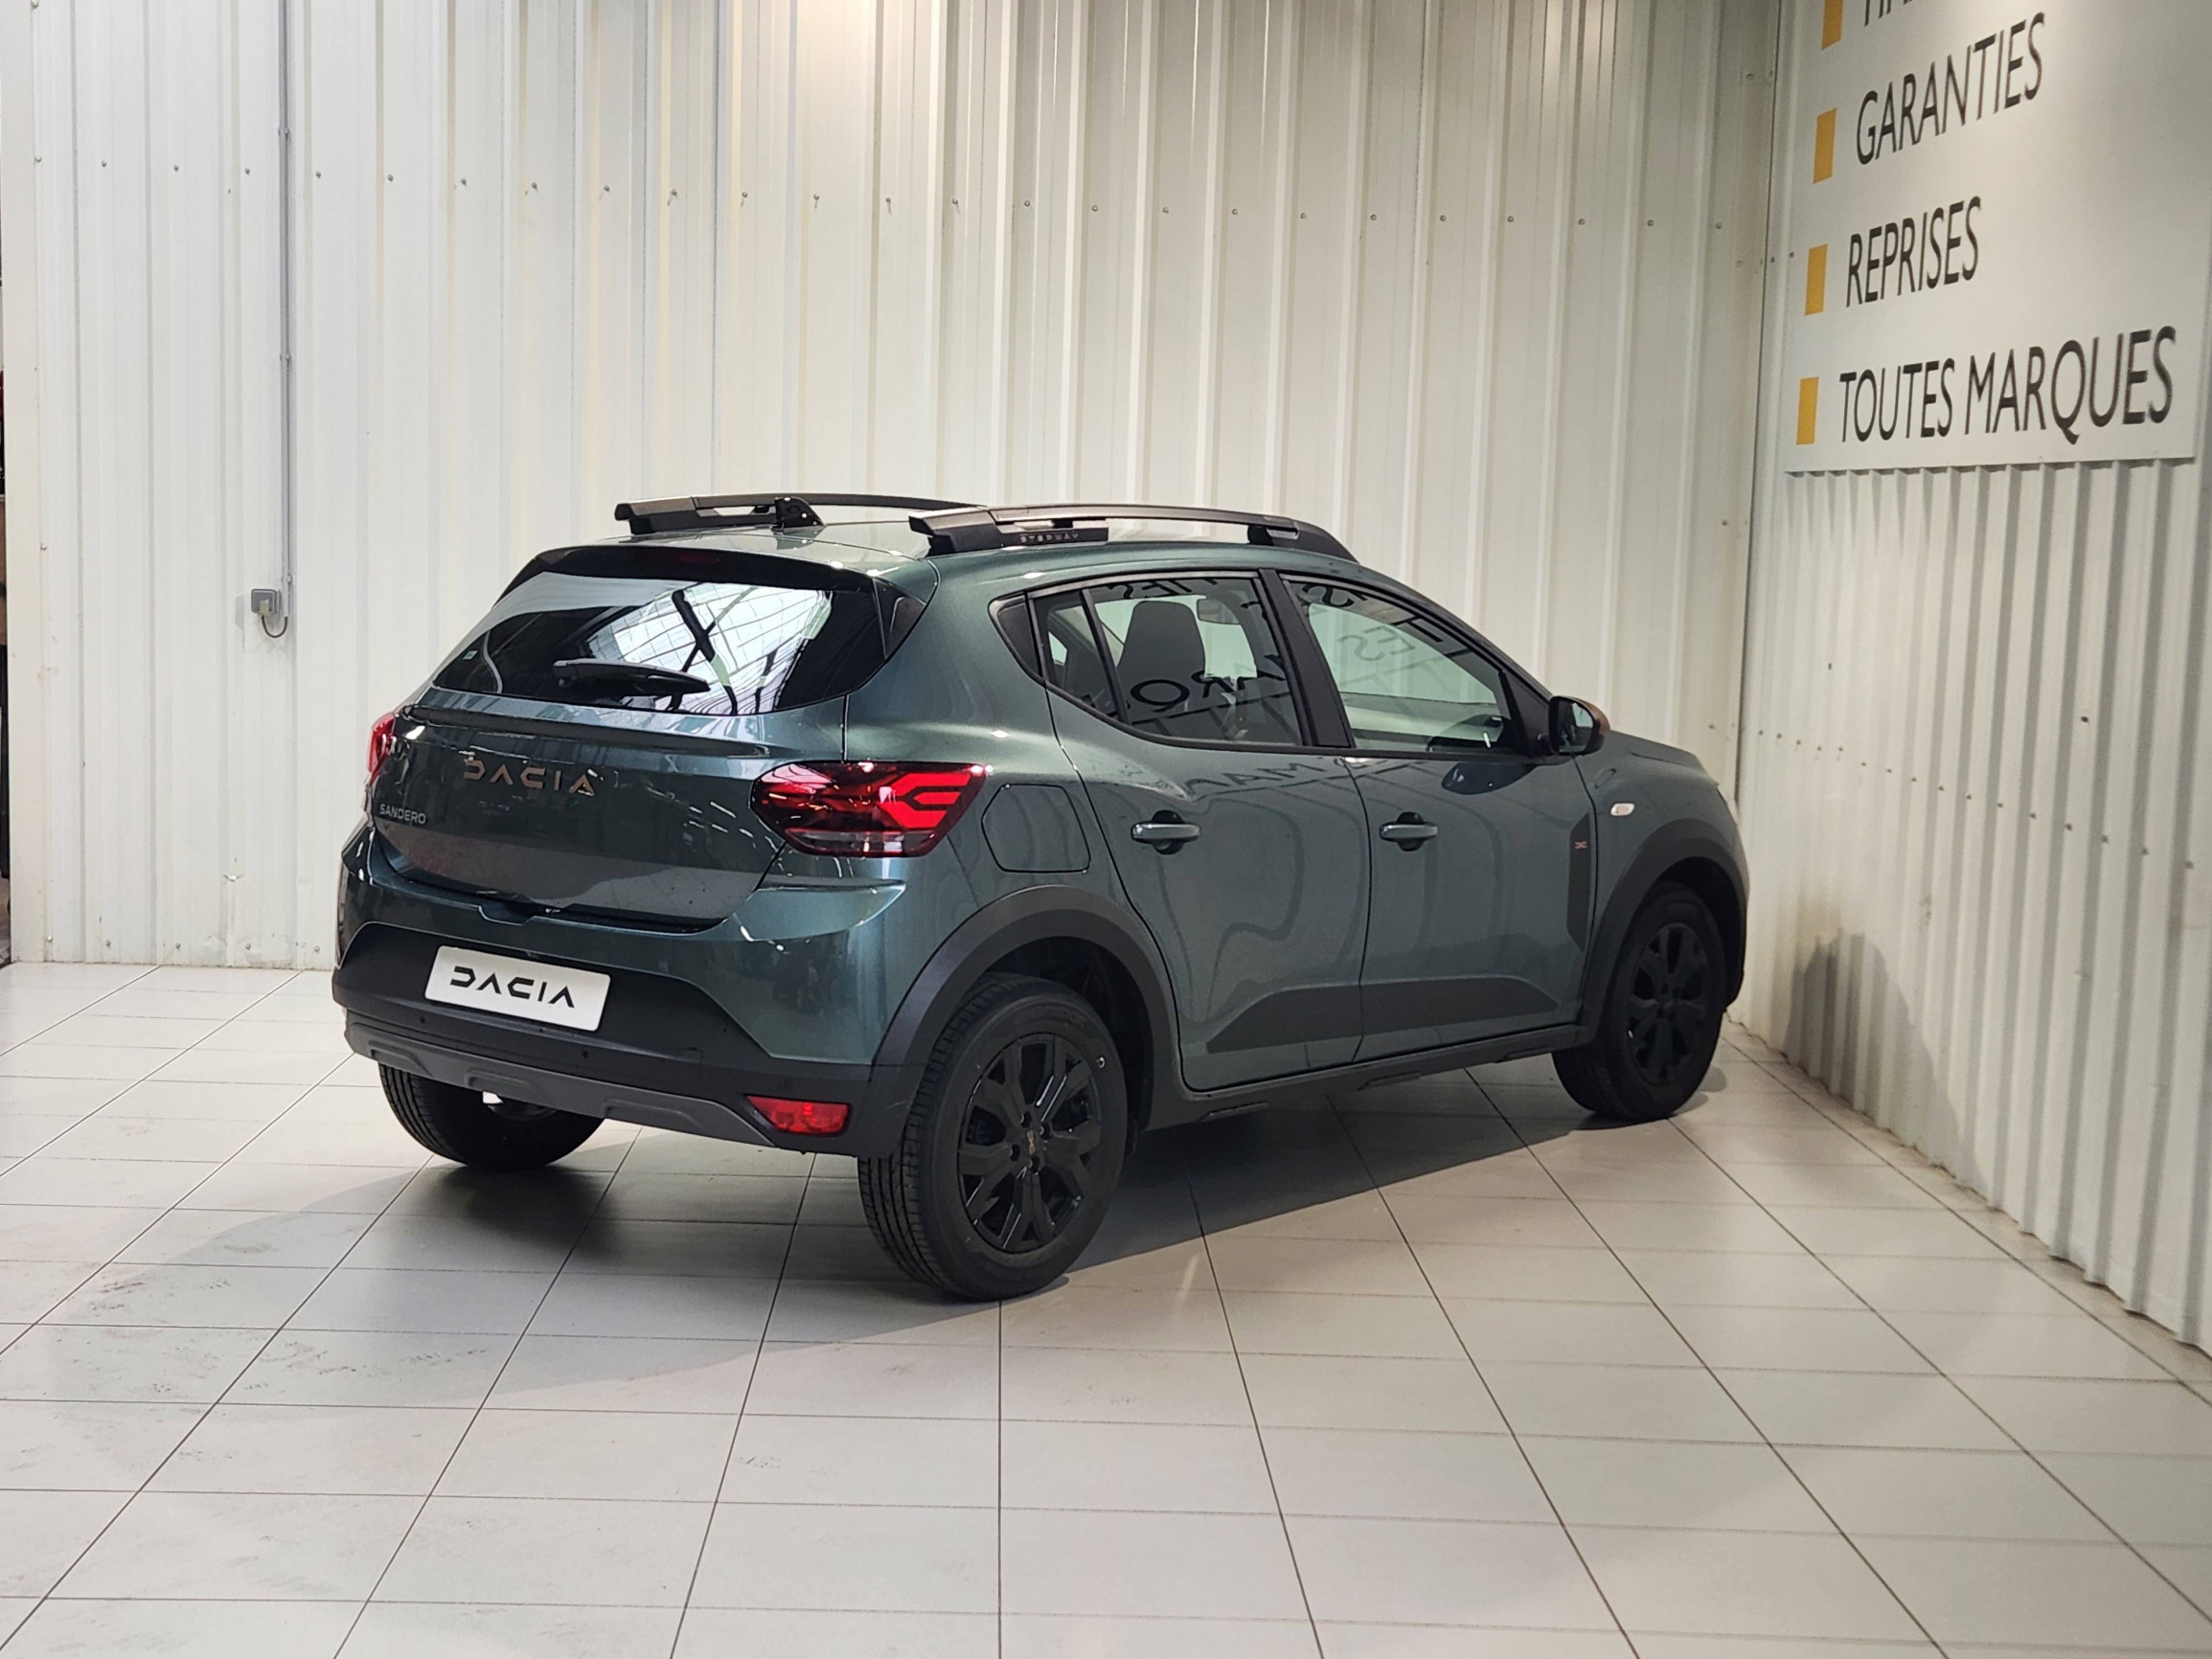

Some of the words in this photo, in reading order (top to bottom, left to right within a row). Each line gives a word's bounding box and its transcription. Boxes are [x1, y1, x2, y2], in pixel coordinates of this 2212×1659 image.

[1856, 11, 2045, 165] GARANTIES
[1846, 195, 1982, 307] REPRISES
[1839, 357, 1955, 443] TOUTES
[1964, 326, 2177, 445] MARQUES
[1019, 533, 1079, 544] STEPWAY
[463, 759, 595, 796] DACIA
[379, 803, 427, 825] SANDERO
[449, 966, 575, 1009] DACIA
